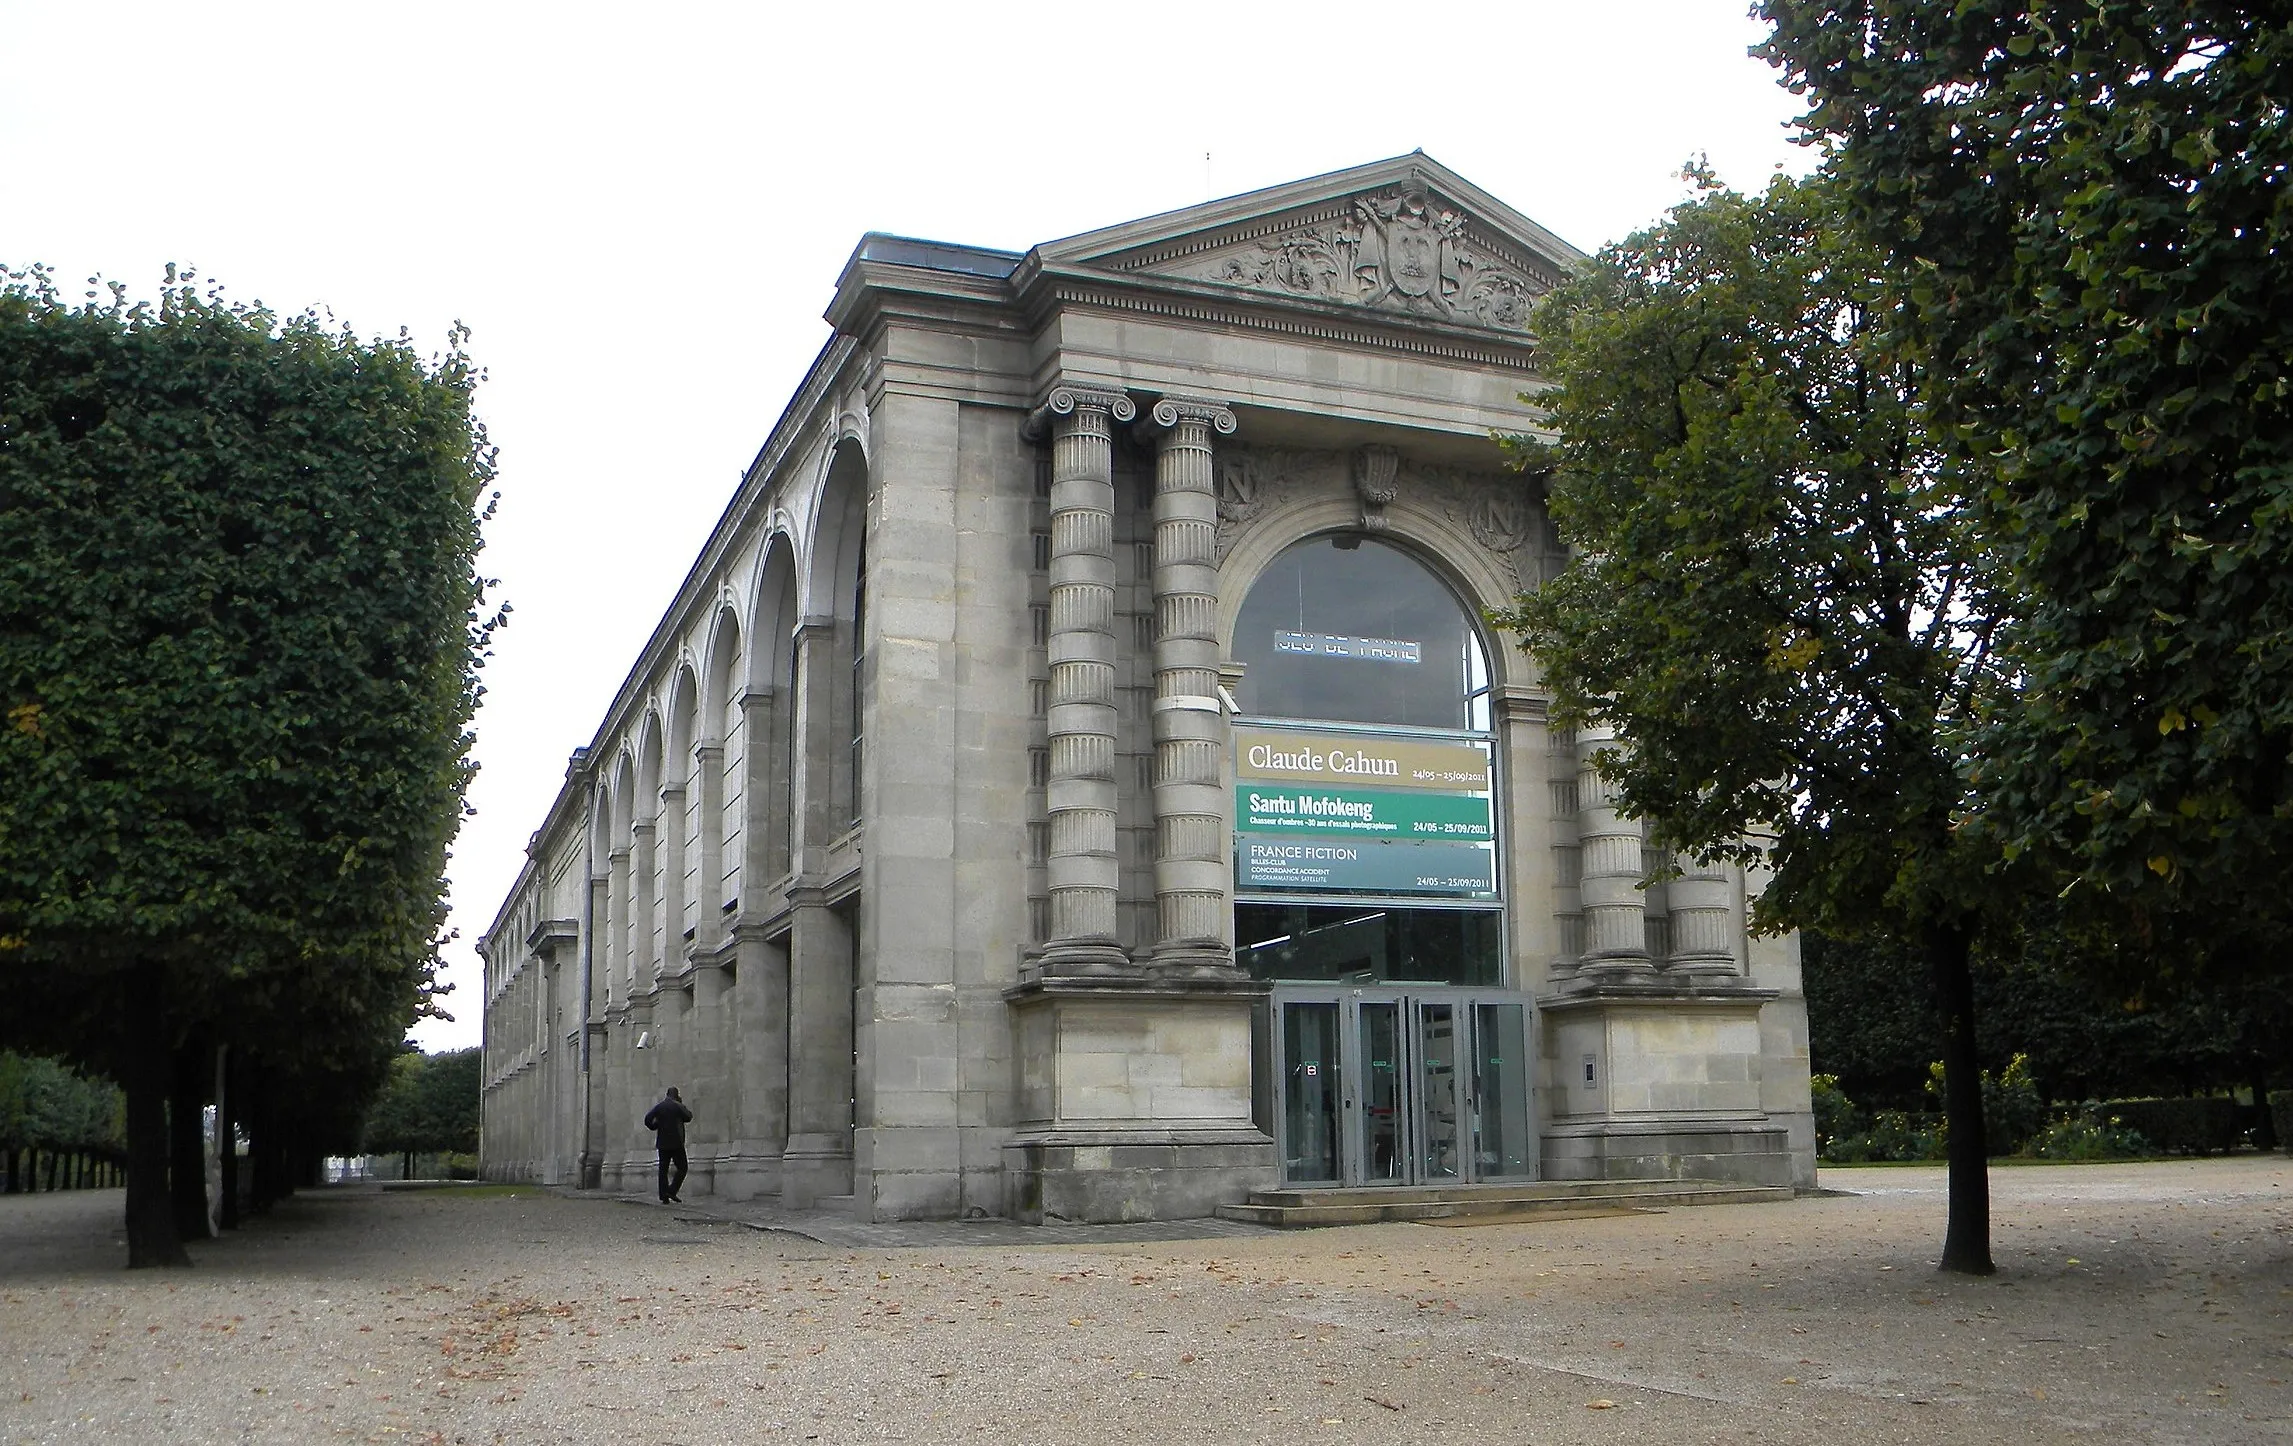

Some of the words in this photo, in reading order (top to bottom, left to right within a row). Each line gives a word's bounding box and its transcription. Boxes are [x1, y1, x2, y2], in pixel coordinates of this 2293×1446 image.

[1248, 744, 1324, 771] Claude
[1328, 750, 1400, 776] Cahun
[1412, 769, 1435, 781] 24/05
[1443, 771, 1486, 782] 25/09/2011
[1249, 793, 1296, 814] Santu
[1299, 795, 1374, 822] Mofokeng
[1249, 816, 1277, 826] Chasseur
[1350, 820, 1398, 831] photographiques
[1413, 822, 1438, 833] 24/05
[1444, 823, 1488, 834] 25/09/2011
[1250, 845, 1302, 859] FRANCE
[1305, 847, 1357, 861] FICTION
[1250, 866, 1300, 875] CONCORDANCE
[1251, 874, 1300, 882] PROGRAMMATION
[1300, 875, 1328, 883] SATELLITE
[1416, 876, 1439, 886] 24/05
[1447, 878, 1489, 888] 25/09/2011
